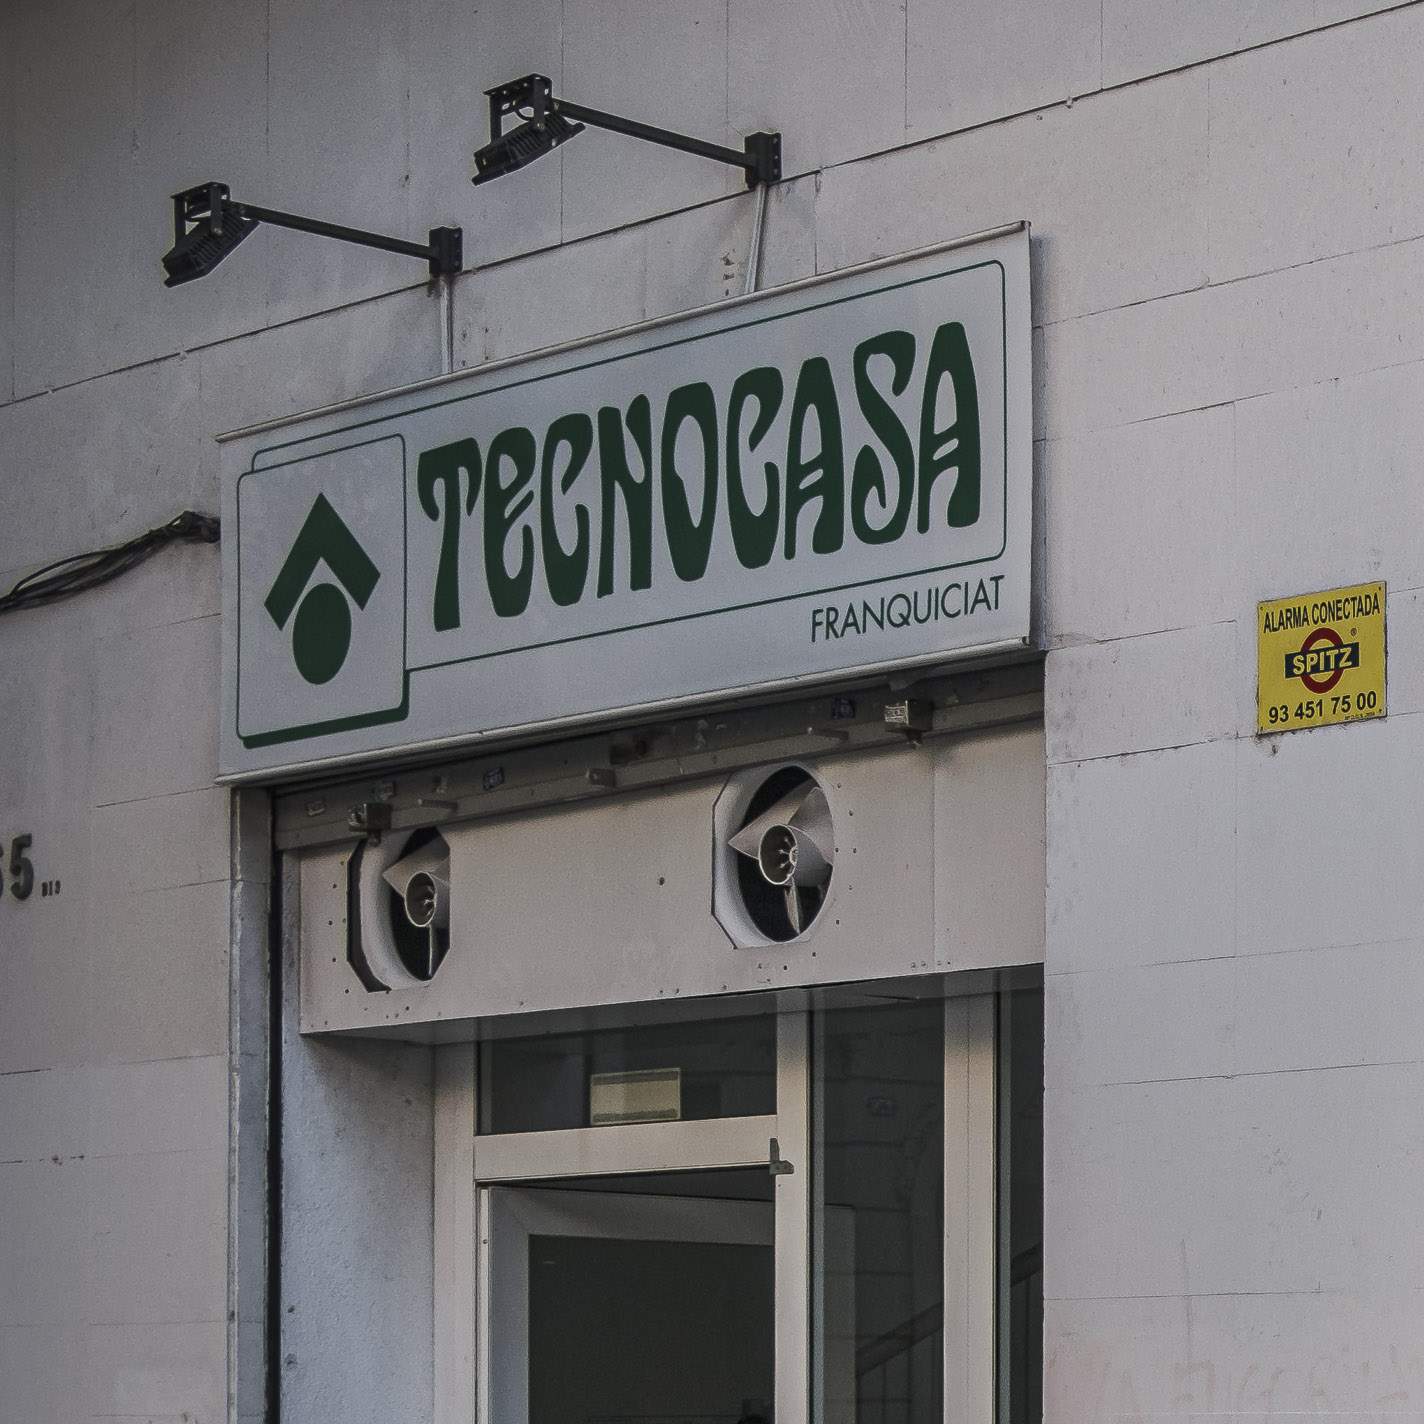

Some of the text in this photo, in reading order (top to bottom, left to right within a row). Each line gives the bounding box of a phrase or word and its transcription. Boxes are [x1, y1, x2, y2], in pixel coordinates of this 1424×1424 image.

[417, 321, 981, 632] TECNOCASA
[810, 575, 1005, 643] FRANQUICIAT
[1263, 592, 1380, 633] ALARMA CONECTADA
[1293, 648, 1352, 675] SPITZ
[1269, 705, 1289, 724] 93
[1294, 699, 1323, 720] 451
[1331, 694, 1351, 715] 75
[1357, 691, 1377, 710] 00
[0, 833, 34, 900] 5
